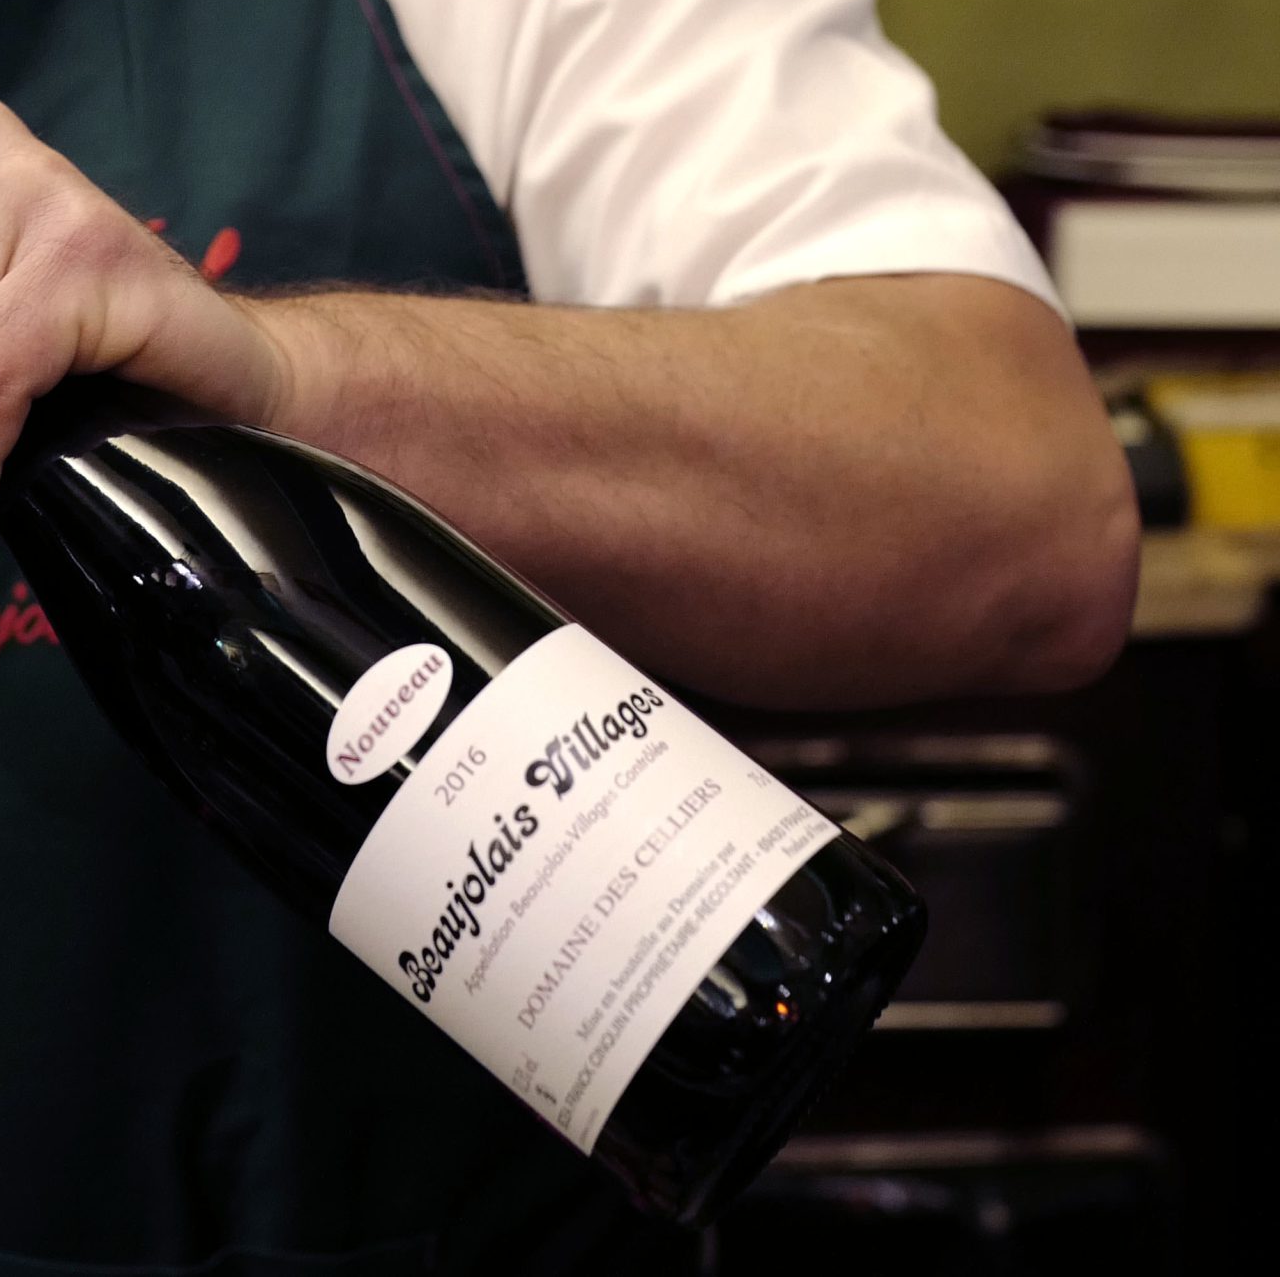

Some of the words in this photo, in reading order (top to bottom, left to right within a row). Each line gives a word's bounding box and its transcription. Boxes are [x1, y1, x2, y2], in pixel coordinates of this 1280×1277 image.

[335, 653, 445, 777] Nouveau
[434, 744, 487, 808] 2016
[398, 803, 539, 1003] Beaujolais
[524, 686, 665, 802] Villages
[517, 912, 602, 1031] DOMAINE
[593, 864, 639, 918] DES
[634, 777, 723, 868] CELLIERS
[463, 915, 517, 997] Appellation
[576, 1006, 606, 1041] Mise
[668, 858, 721, 914] Domaine
